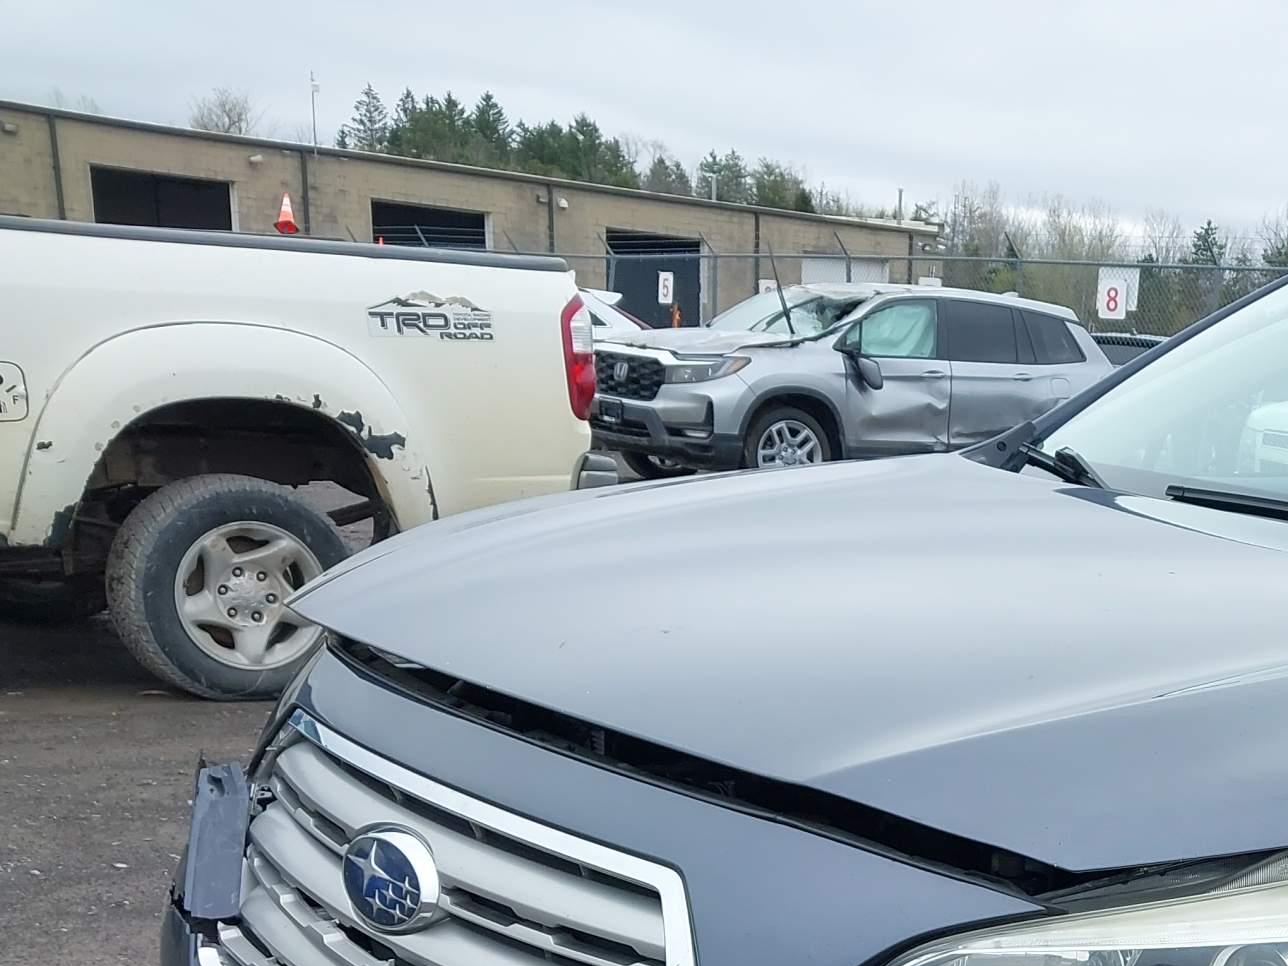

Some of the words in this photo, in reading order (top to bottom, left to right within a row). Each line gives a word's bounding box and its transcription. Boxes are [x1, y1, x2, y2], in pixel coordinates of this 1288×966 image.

[662, 278, 669, 298] 5
[1106, 287, 1118, 312] 8
[368, 311, 451, 336] TRD
[453, 322, 492, 330] OFF
[440, 332, 494, 340] ROAD
